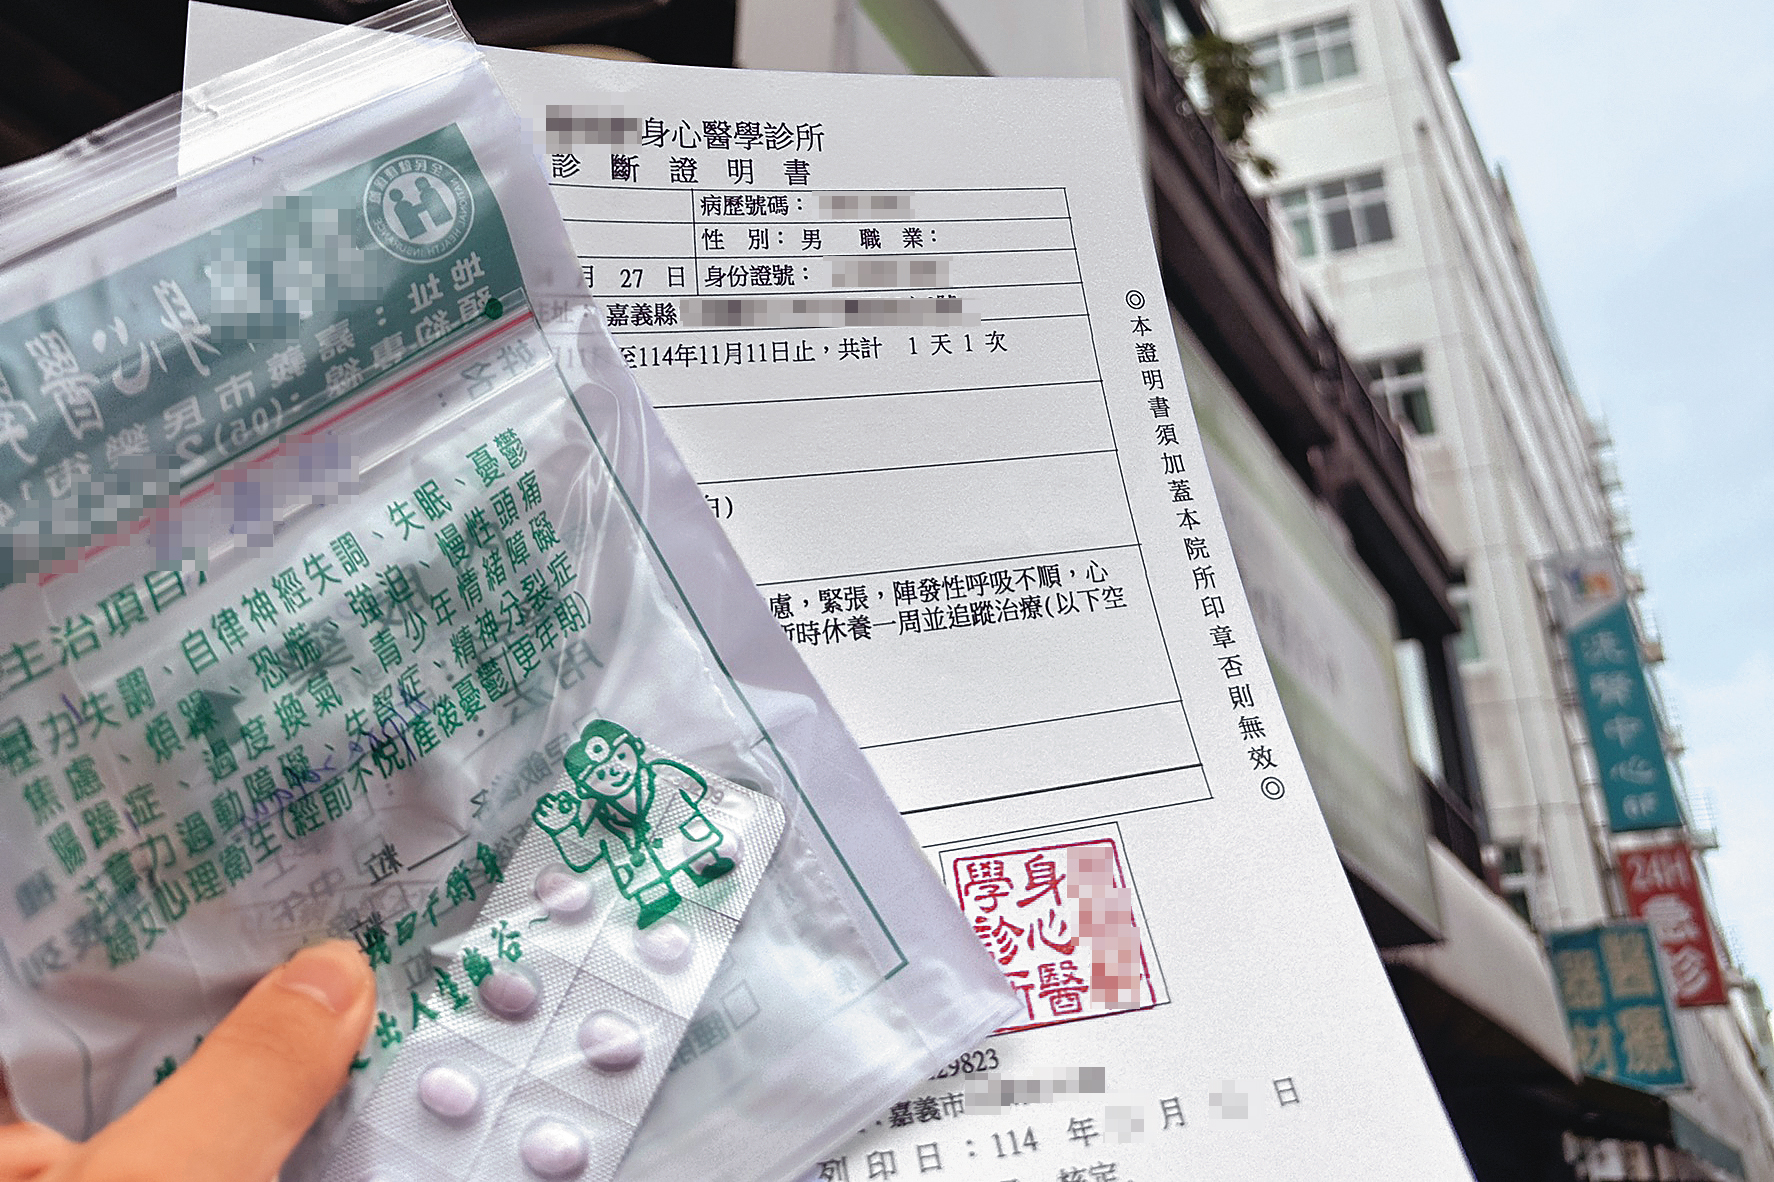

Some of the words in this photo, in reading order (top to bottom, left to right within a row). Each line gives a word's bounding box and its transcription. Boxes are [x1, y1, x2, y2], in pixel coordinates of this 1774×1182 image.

[641, 117, 825, 152] 身心醫學診所
[801, 228, 822, 251] 男
[620, 268, 643, 288] 27
[667, 265, 685, 288] 日
[909, 336, 918, 355] 1
[930, 334, 952, 356] 天
[964, 334, 972, 353] 1
[985, 331, 1007, 354] 次
[990, 1125, 1039, 1160] 114
[1066, 1115, 1099, 1148] 年
[1159, 1096, 1187, 1130] 月
[1273, 1076, 1301, 1108] 日
